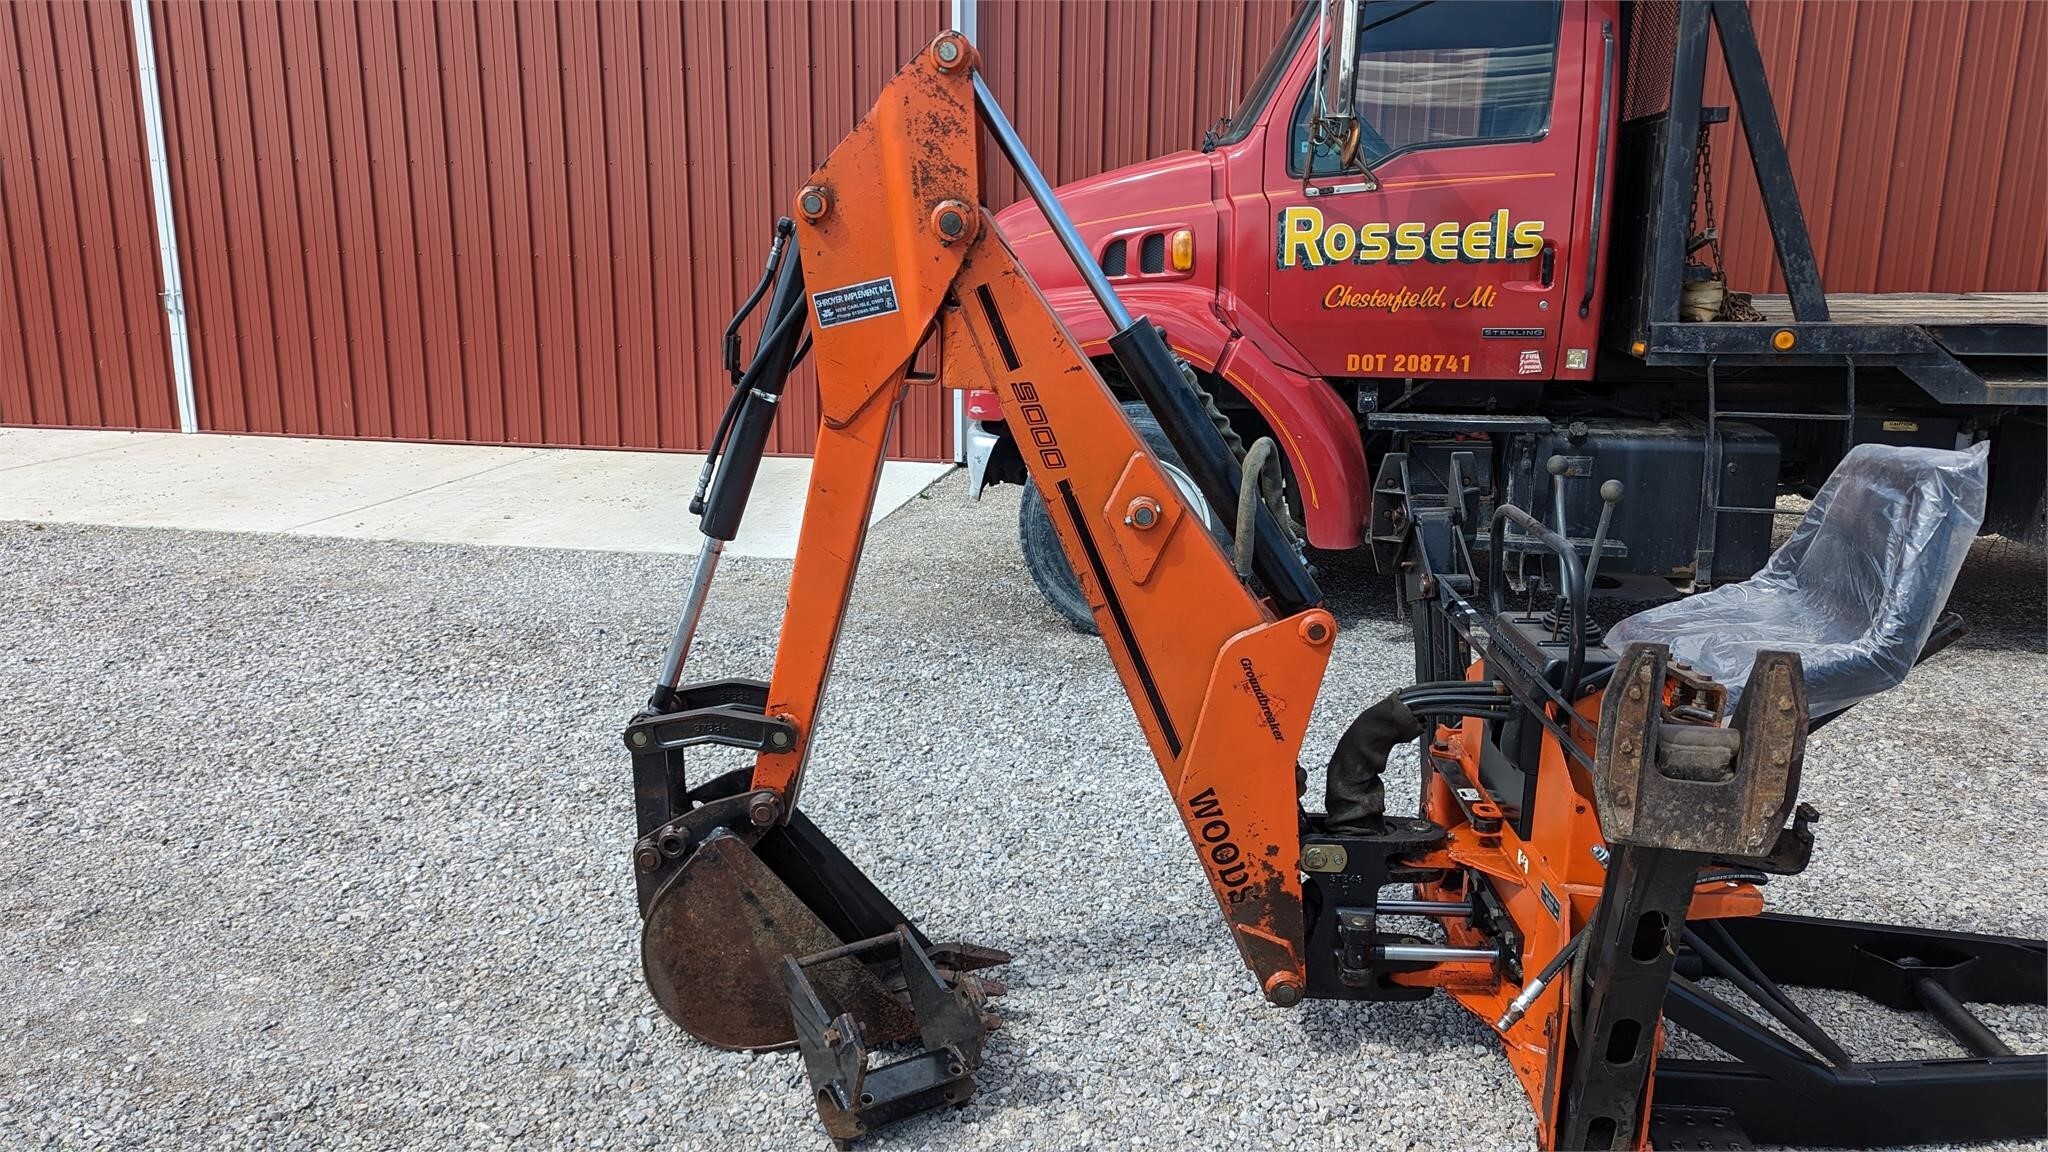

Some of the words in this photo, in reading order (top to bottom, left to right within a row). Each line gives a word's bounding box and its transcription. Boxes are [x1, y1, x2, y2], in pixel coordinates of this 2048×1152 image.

[1281, 206, 1545, 269] Rosseels
[815, 295, 844, 308] SHROYER
[879, 284, 892, 293] INC.
[871, 297, 884, 305] OHIO
[1323, 284, 1448, 313] Chesterfield,
[1454, 285, 1498, 309] Mi
[1484, 329, 1544, 337] STERLING
[1346, 353, 1388, 373] DOT
[1393, 353, 1471, 373] 208741
[1011, 382, 1066, 469] 9000
[1240, 657, 1285, 742] Groundbreaker
[1188, 787, 1254, 904] WOODS
